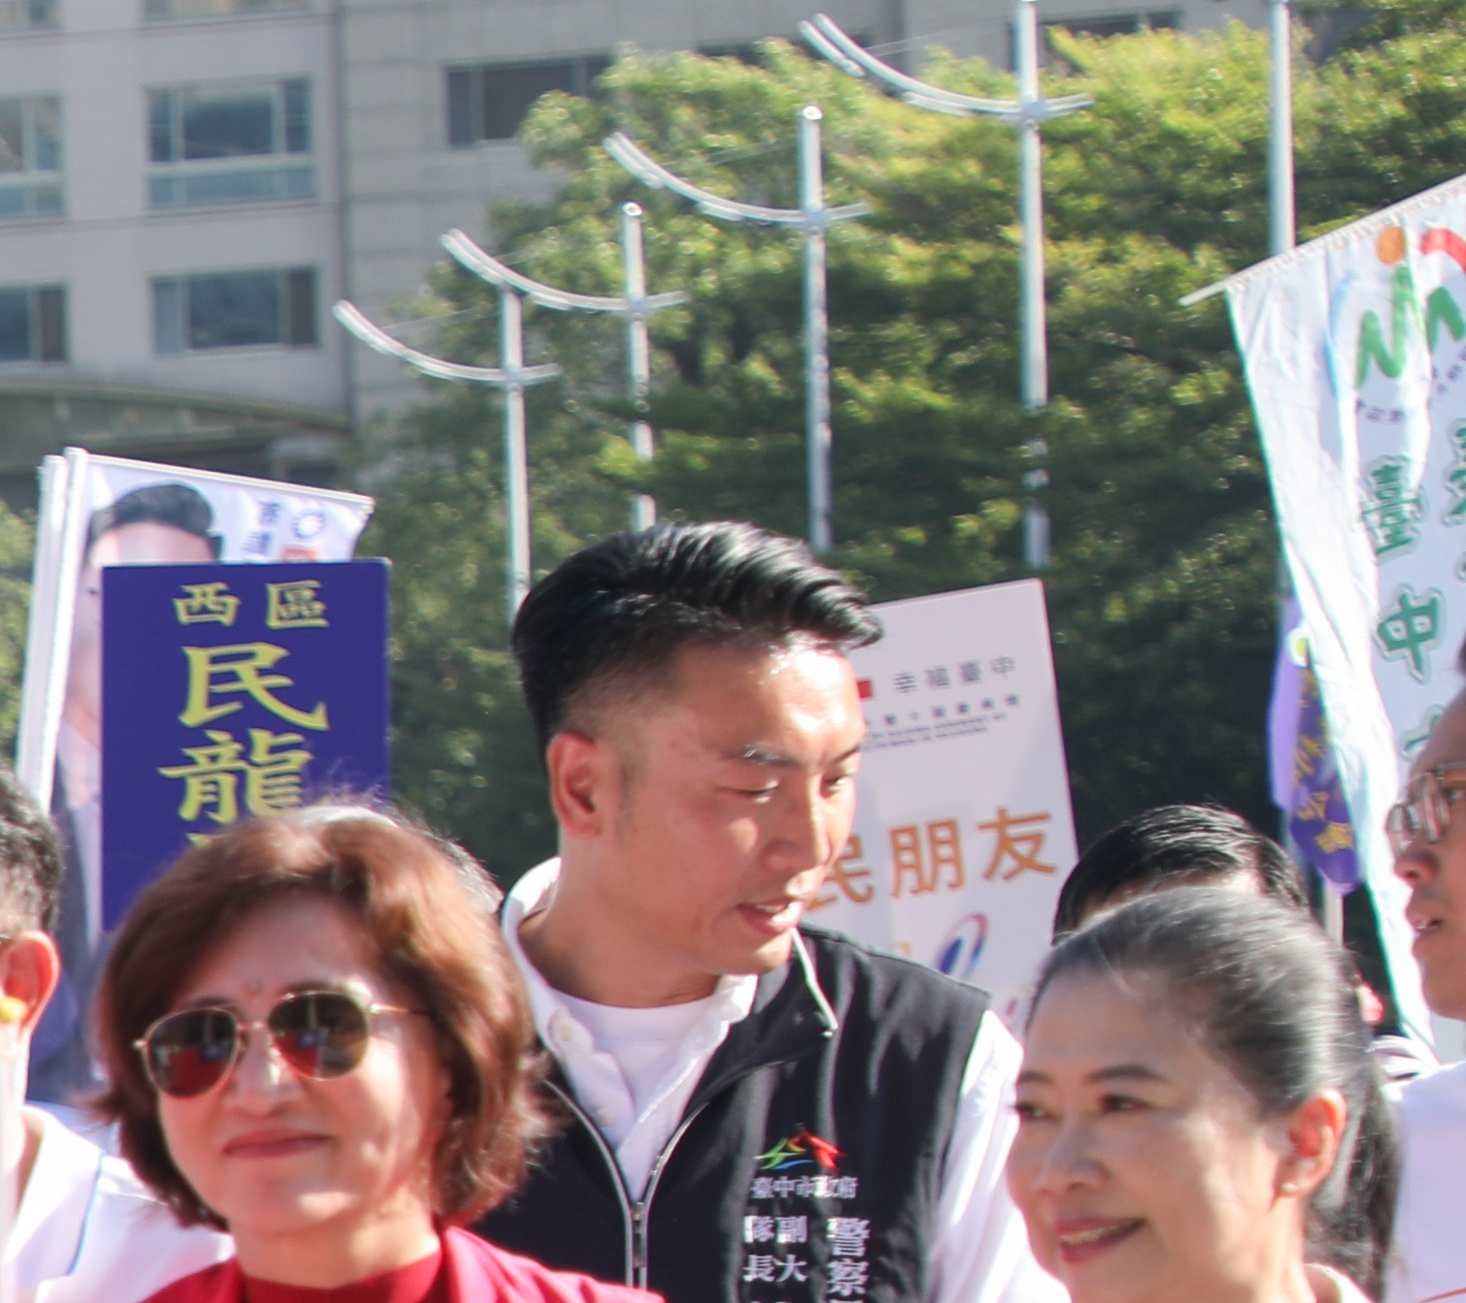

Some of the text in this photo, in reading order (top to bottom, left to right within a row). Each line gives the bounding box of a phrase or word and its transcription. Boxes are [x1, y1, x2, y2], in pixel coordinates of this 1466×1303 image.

[173, 579, 329, 630] 西區
[158, 640, 329, 849] 民龍
[751, 1175, 859, 1200] 臺中市政府
